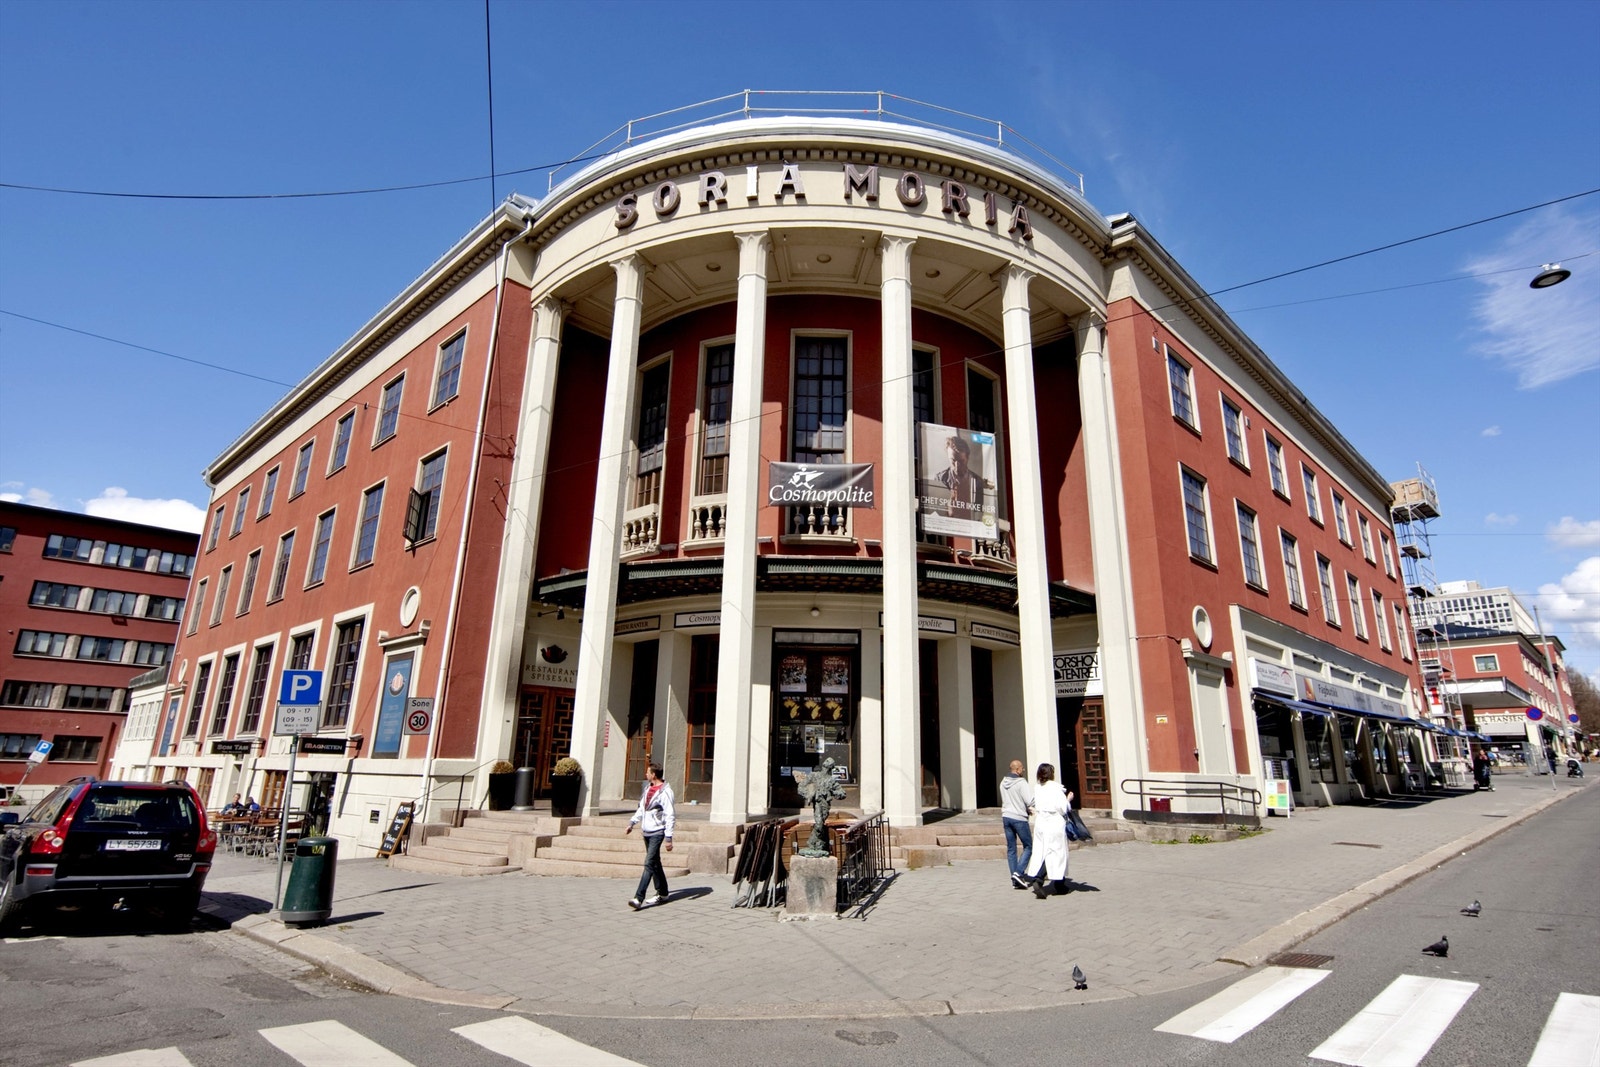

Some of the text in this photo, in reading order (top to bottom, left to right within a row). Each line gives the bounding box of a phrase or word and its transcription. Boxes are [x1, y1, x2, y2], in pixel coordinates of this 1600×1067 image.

[615, 164, 1034, 241] SORIA MORIA
[769, 485, 873, 507] Cosmopolite
[940, 497, 965, 509] SPILLER
[966, 502, 981, 512] IKKE
[982, 505, 996, 513] HER
[525, 664, 578, 676] RESTAURAN
[1060, 667, 1098, 680] TEATRET
[290, 674, 313, 701] P
[412, 715, 426, 727] 30
[38, 742, 49, 751] P
[304, 742, 343, 750] MAGNETEN
[109, 840, 158, 849] LY 55738
